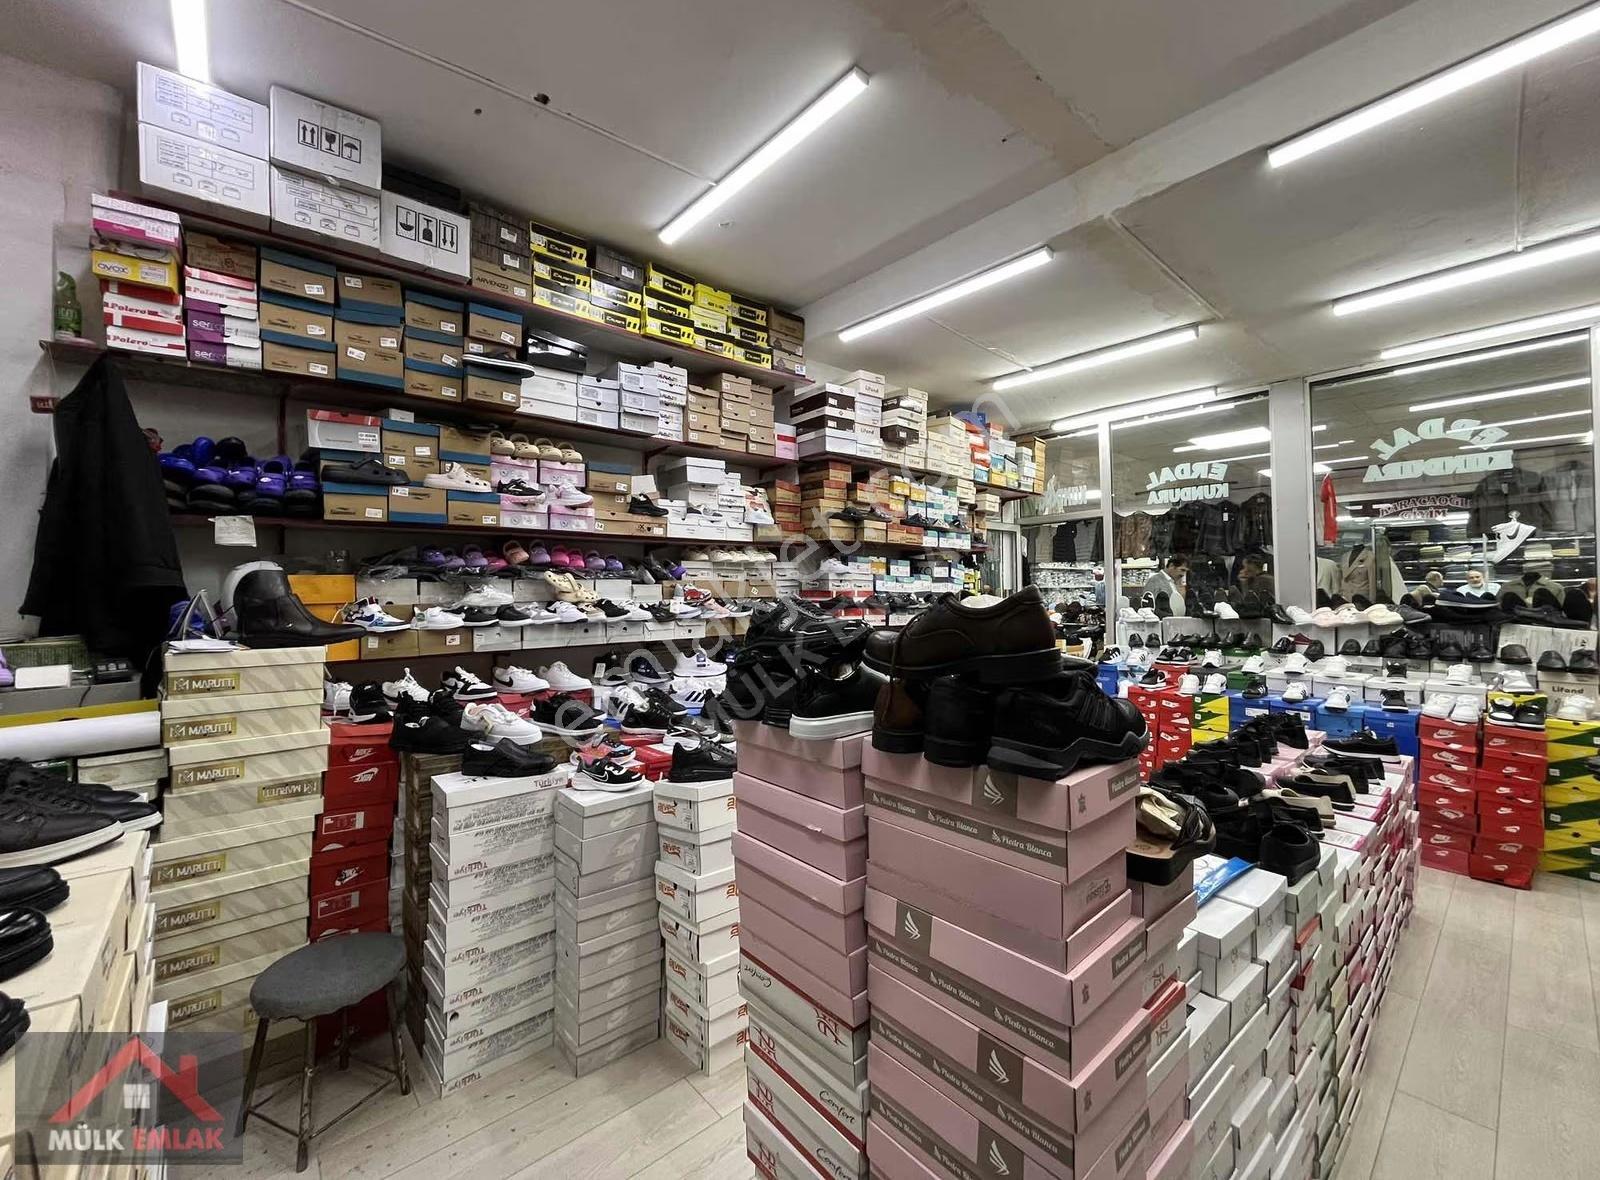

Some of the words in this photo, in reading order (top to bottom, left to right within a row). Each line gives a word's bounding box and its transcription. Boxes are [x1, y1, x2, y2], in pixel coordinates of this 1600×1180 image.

[192, 678, 235, 690] MARUTTI
[188, 722, 232, 736] MARUTTI
[196, 766, 240, 781] MARUTTI
[263, 784, 301, 798] MARUTTI
[176, 860, 221, 876] MARUTTI
[170, 908, 216, 927] MARUTTI
[169, 953, 215, 974] MARUTTI
[744, 965, 772, 988] Comfort
[171, 998, 217, 1019] MARUTTI
[818, 1089, 855, 1124] Comfort
[816, 1147, 852, 1180] Comfor
